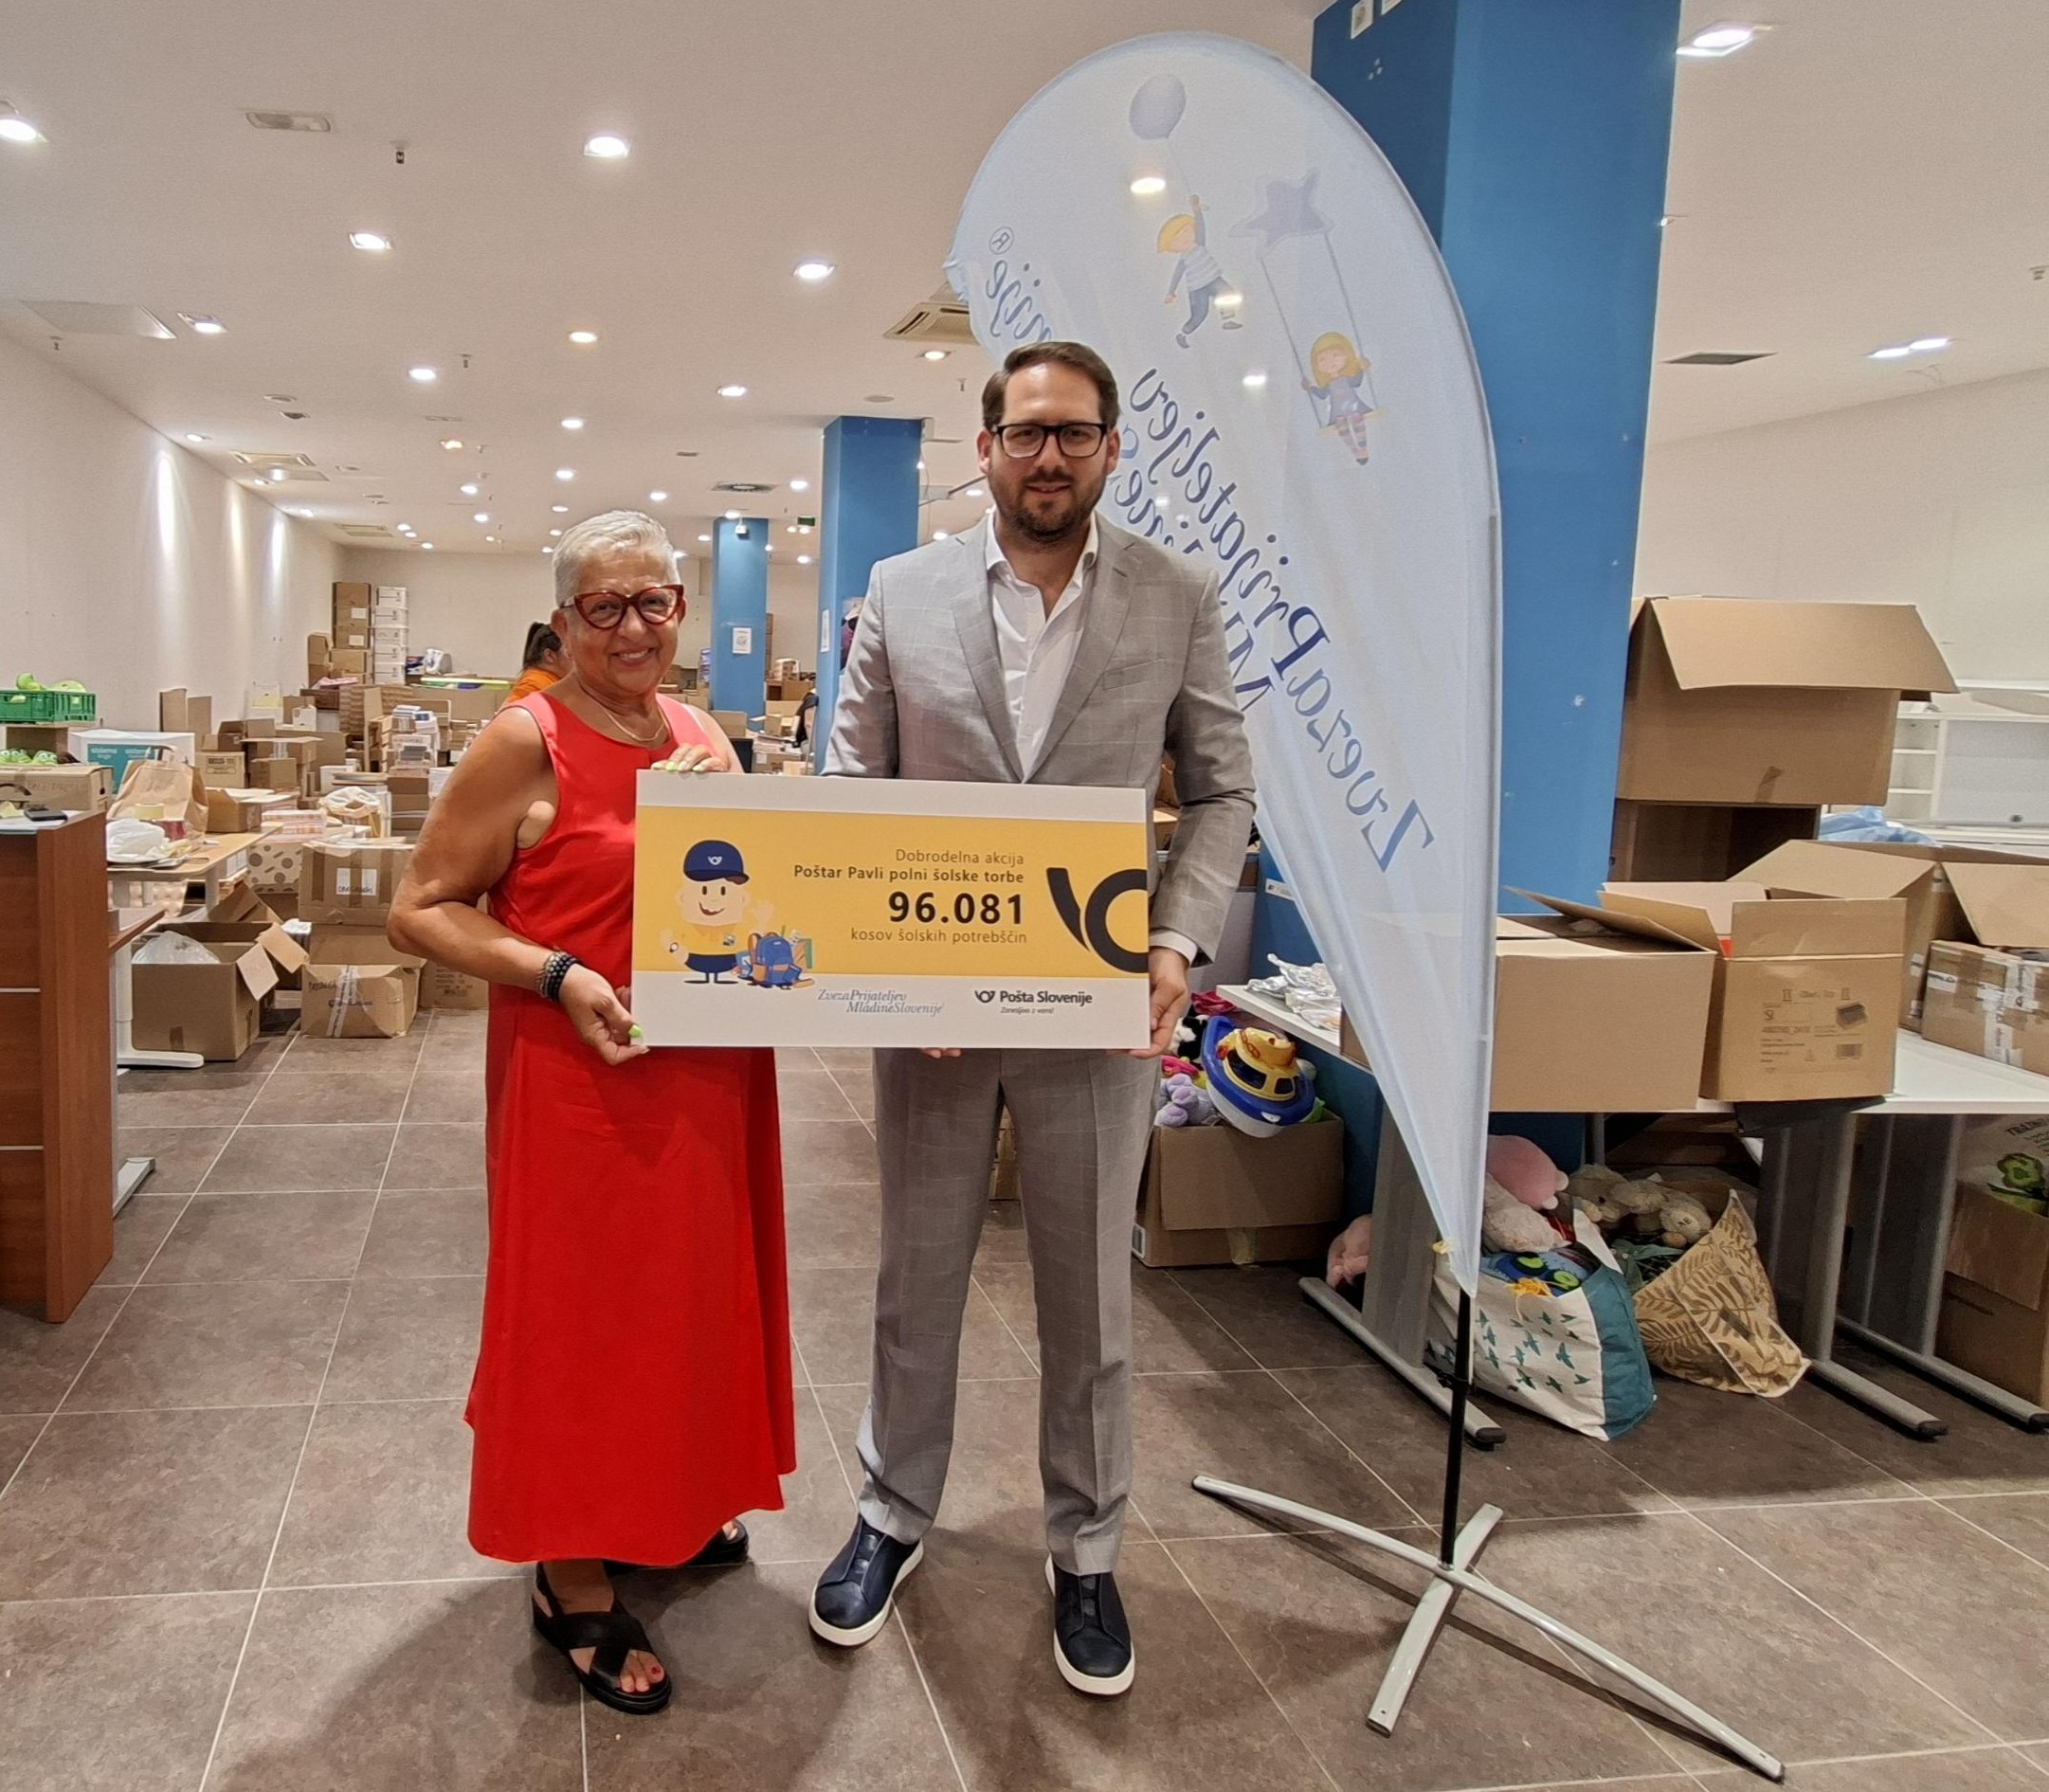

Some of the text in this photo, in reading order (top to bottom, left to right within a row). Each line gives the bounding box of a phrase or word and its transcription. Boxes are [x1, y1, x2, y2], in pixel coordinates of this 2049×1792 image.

[896, 849, 1024, 868] Dobrodelna akcija
[793, 864, 1024, 883] Poštar Pavli polni šolske torbe
[887, 891, 1022, 925] 96.081
[851, 928, 1027, 945] kosov šolskih potrebščin
[1000, 990, 1093, 1006] Pošta Slovenije
